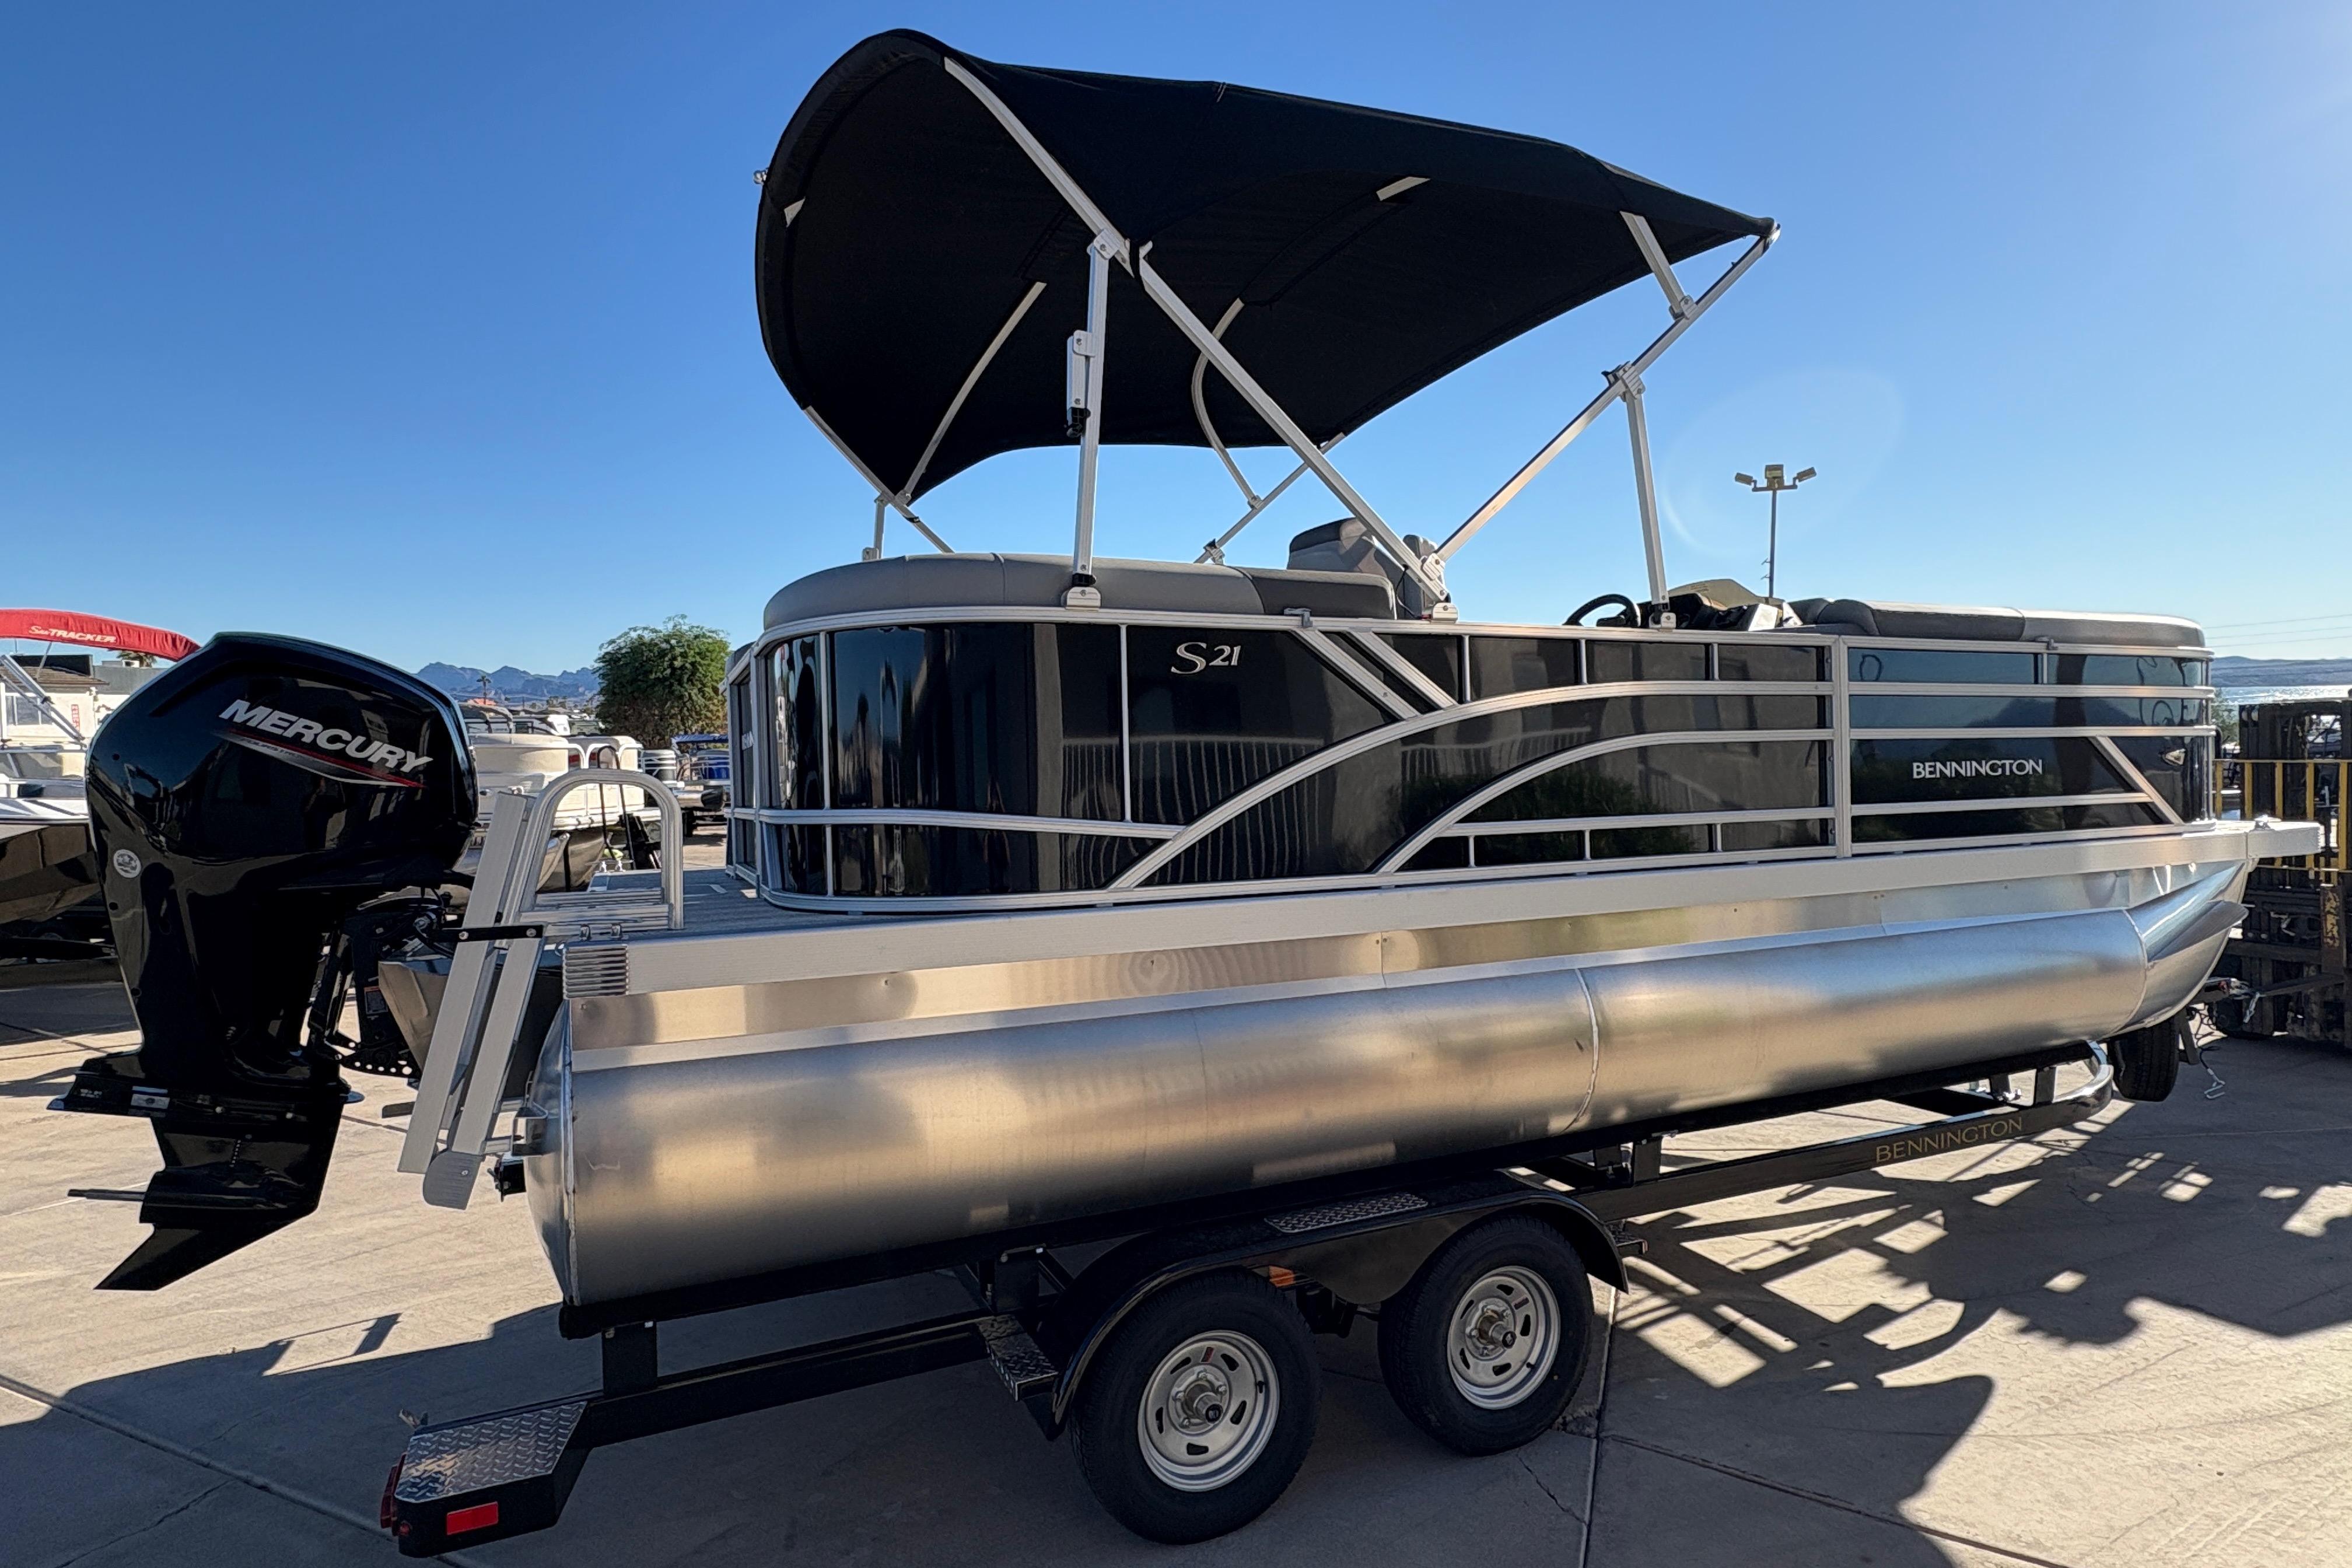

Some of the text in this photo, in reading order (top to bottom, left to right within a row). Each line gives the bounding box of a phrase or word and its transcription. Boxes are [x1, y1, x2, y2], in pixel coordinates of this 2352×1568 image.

[219, 699, 433, 773] MERCURY
[1913, 760, 2042, 779] BENNINGTON
[1876, 1117, 2022, 1163] BENNINGTON
